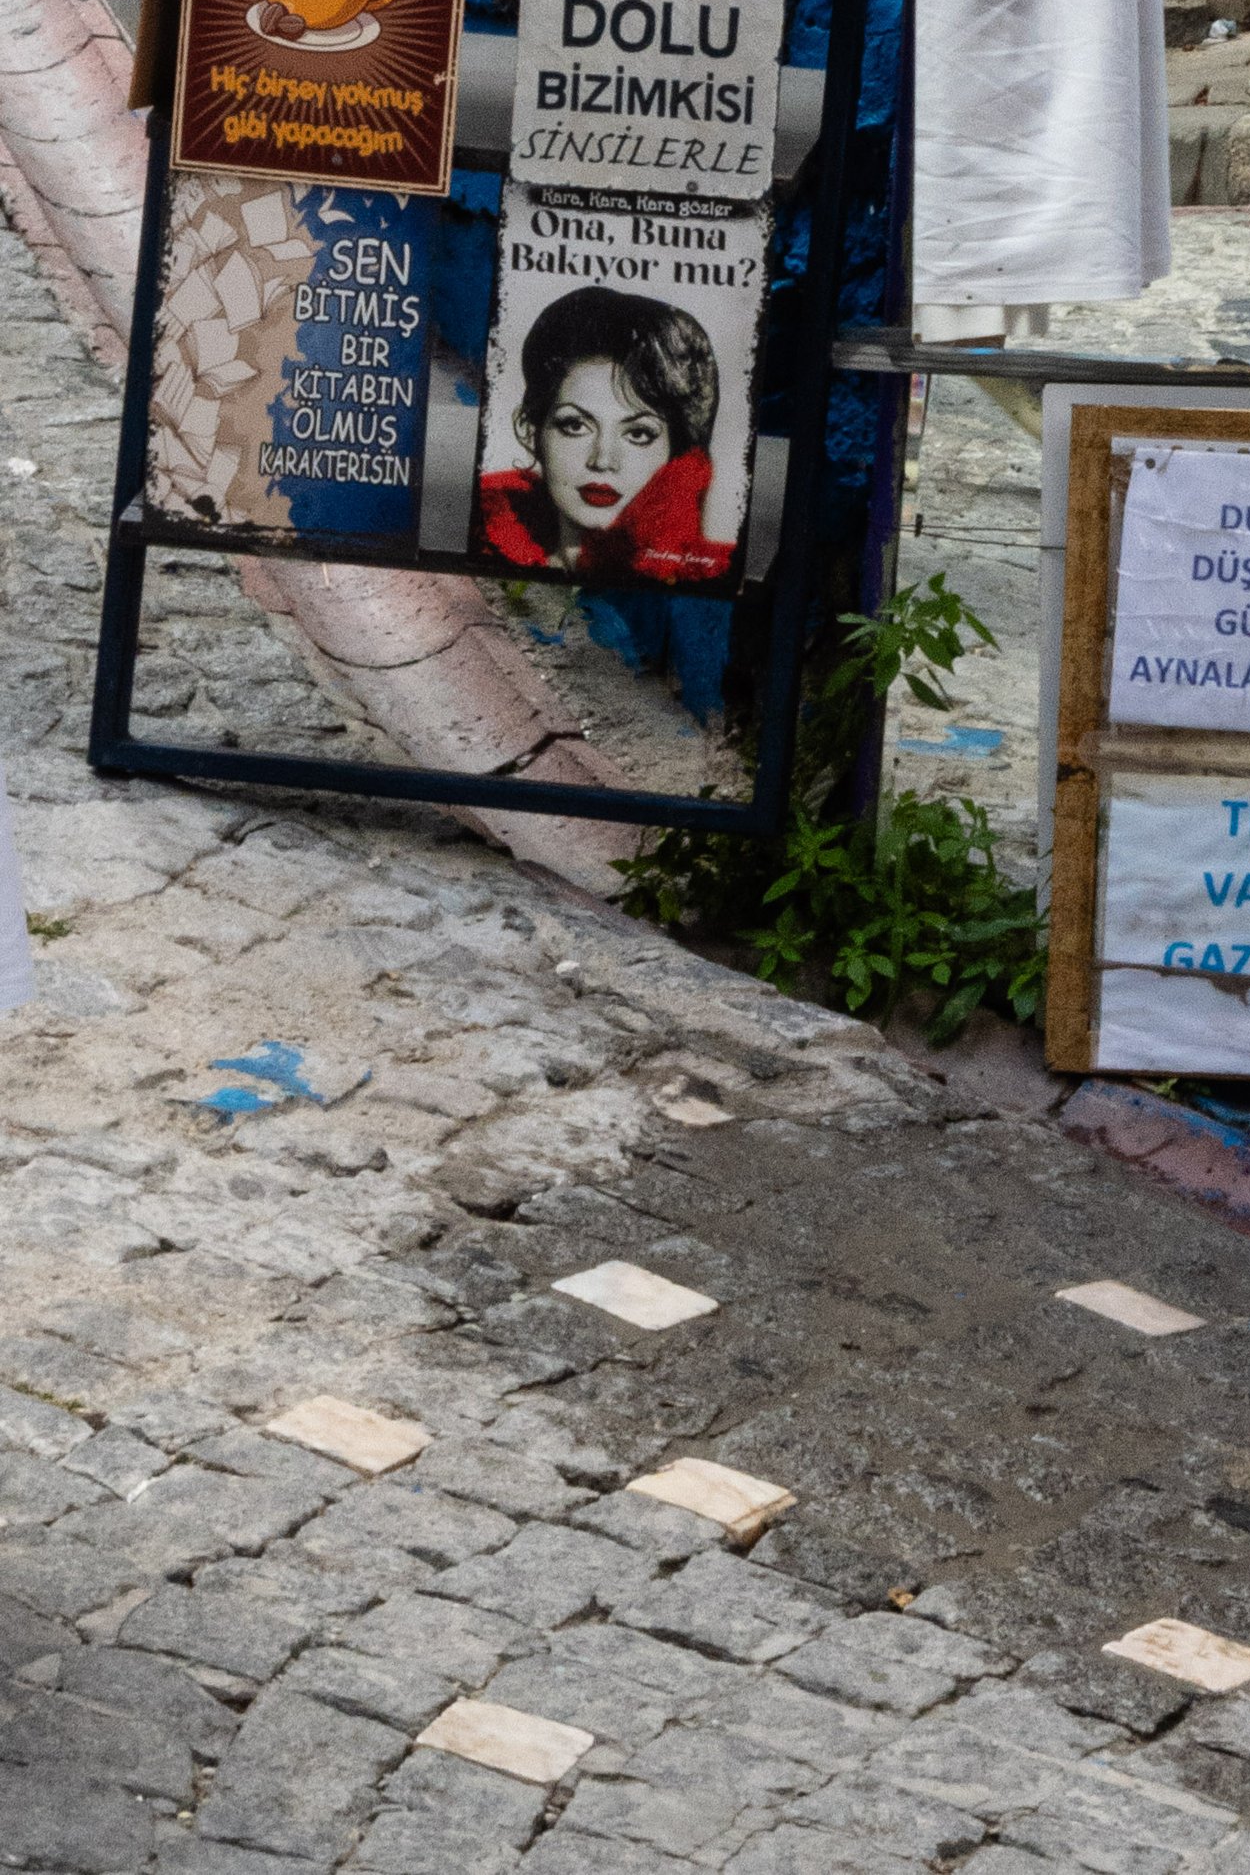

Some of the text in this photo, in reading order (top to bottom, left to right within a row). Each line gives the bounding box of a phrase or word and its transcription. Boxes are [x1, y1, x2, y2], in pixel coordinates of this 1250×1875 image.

[537, 62, 755, 125] BİZİMKİSİ
[224, 114, 269, 144] gibi
[520, 121, 763, 175] SİNSİLERLE
[636, 195, 675, 213] Kara
[531, 211, 727, 251] Ona, Buna
[329, 237, 411, 286] SEN
[512, 243, 757, 288] Bakıyor mu?
[296, 281, 419, 338] BİTMİŞ
[341, 331, 389, 367] BİR
[293, 366, 413, 407] KİTABIN
[292, 400, 397, 447] ÖLMÜŞ
[259, 443, 410, 486] KARAKTERİSİN
